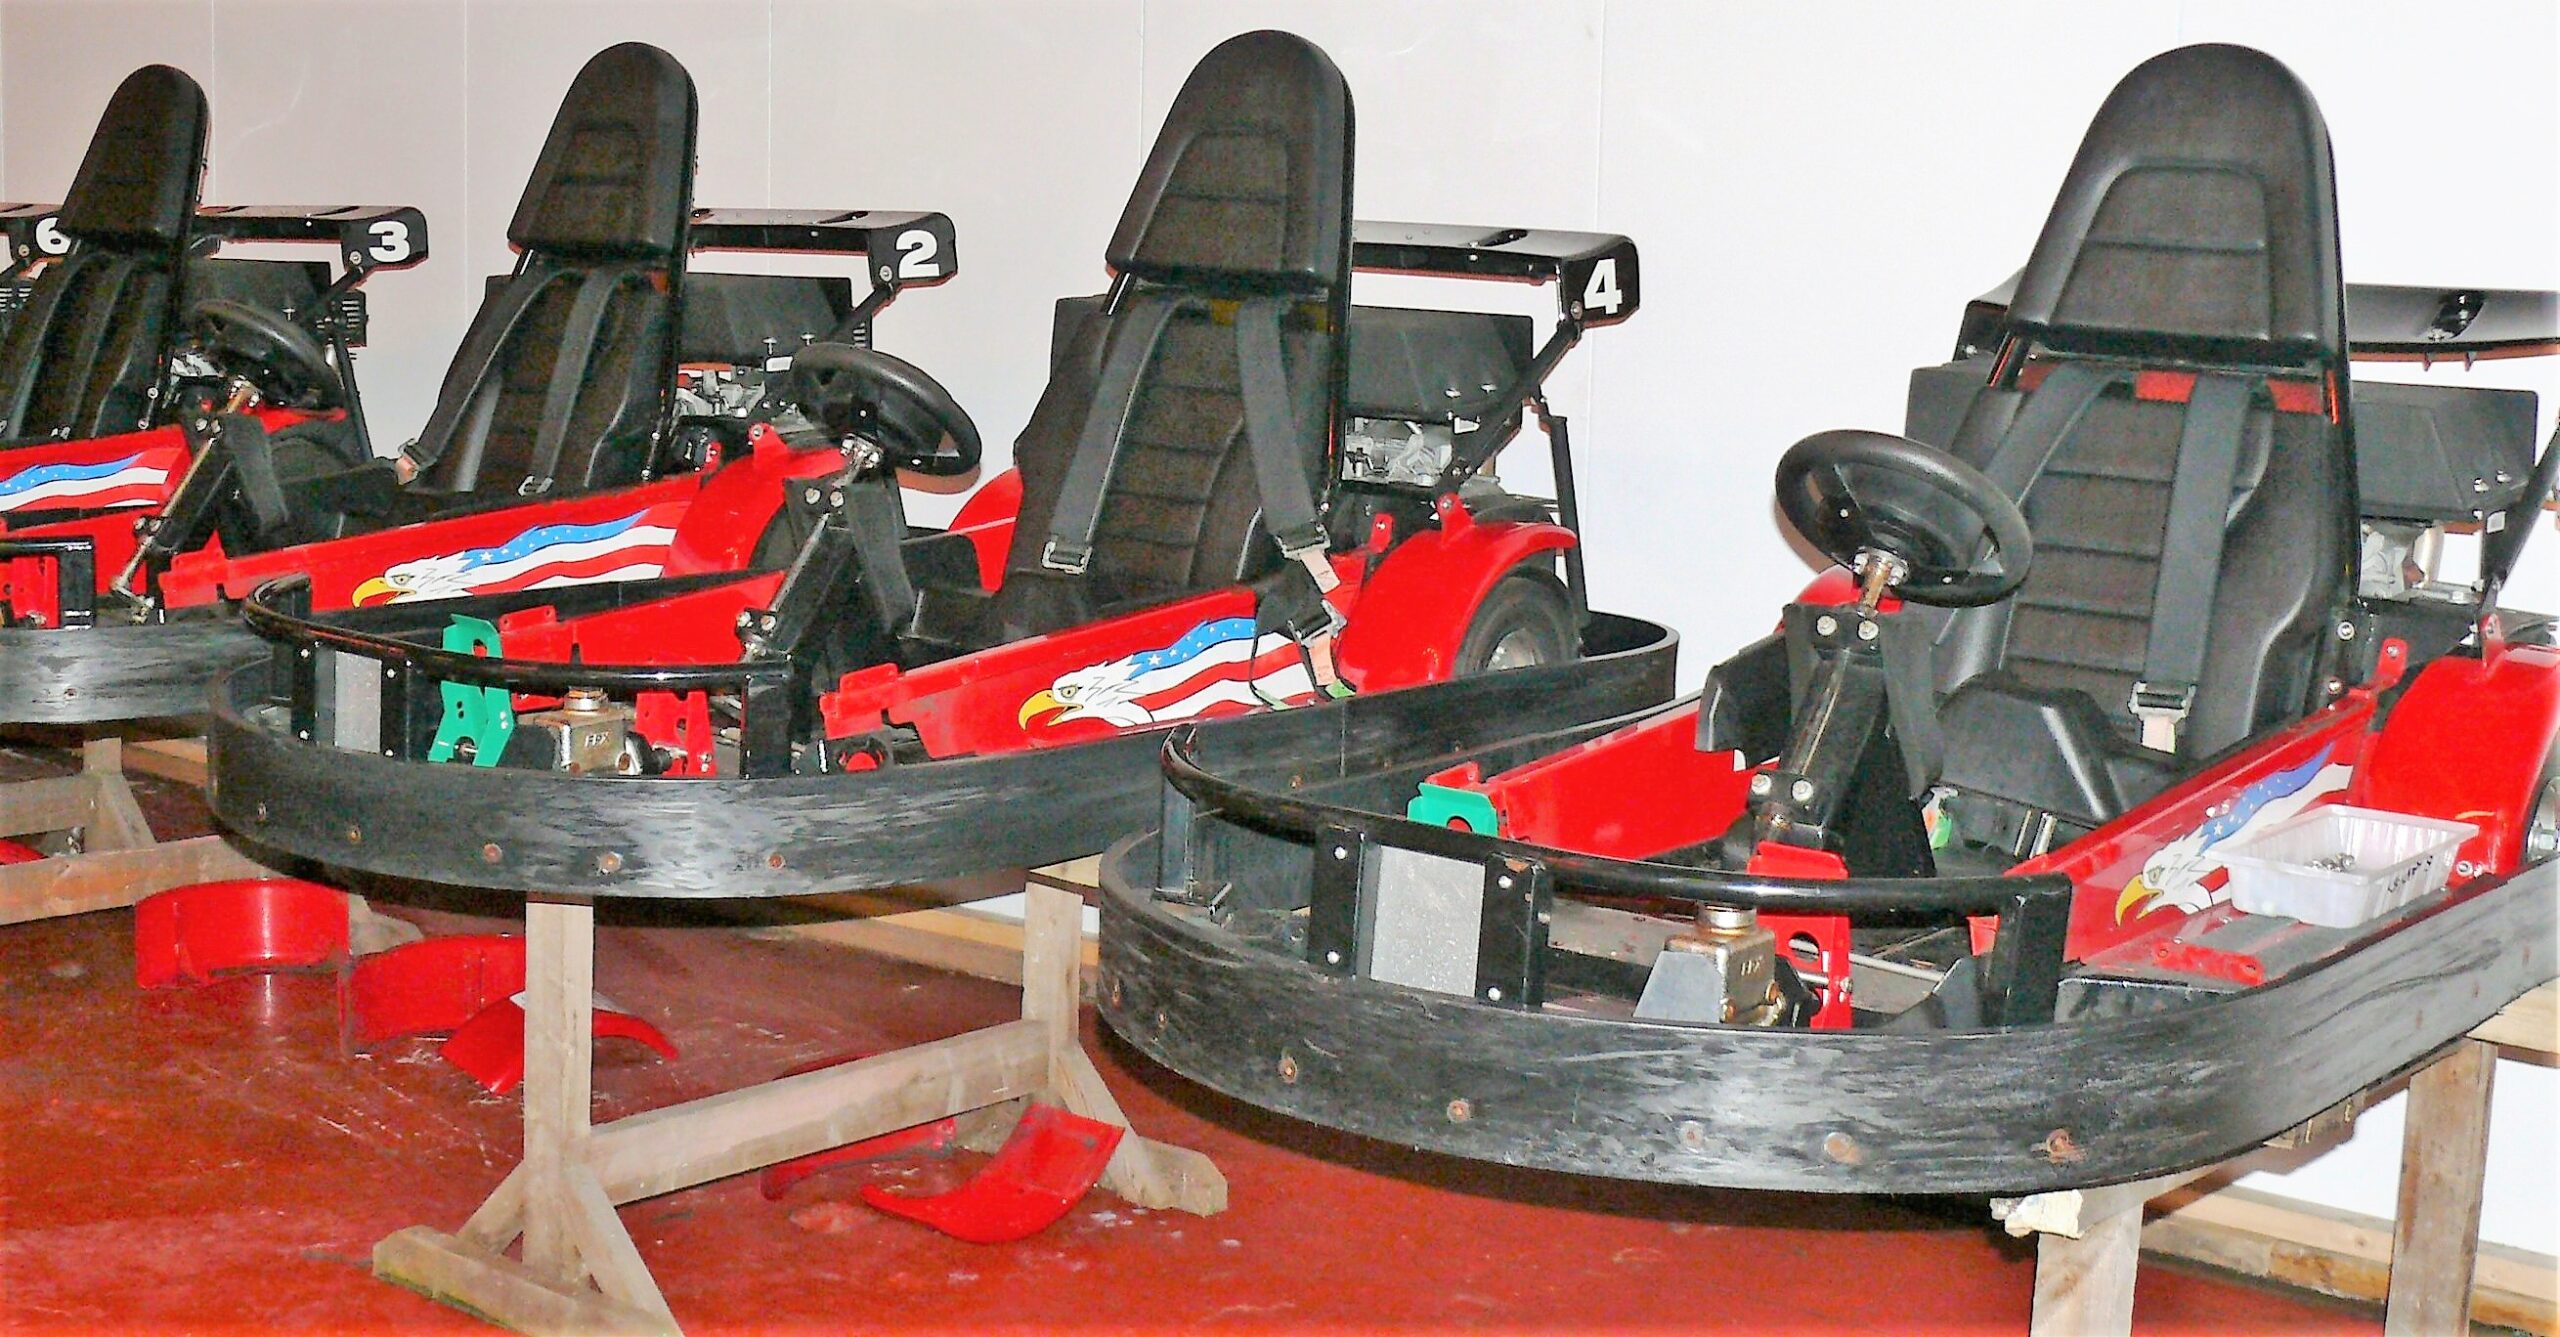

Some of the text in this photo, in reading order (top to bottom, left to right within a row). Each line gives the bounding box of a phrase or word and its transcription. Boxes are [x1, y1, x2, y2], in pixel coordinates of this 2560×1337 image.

[36, 217, 71, 254] 6
[368, 220, 411, 262] 3
[896, 229, 940, 278] 2
[1583, 258, 1623, 314] 4
